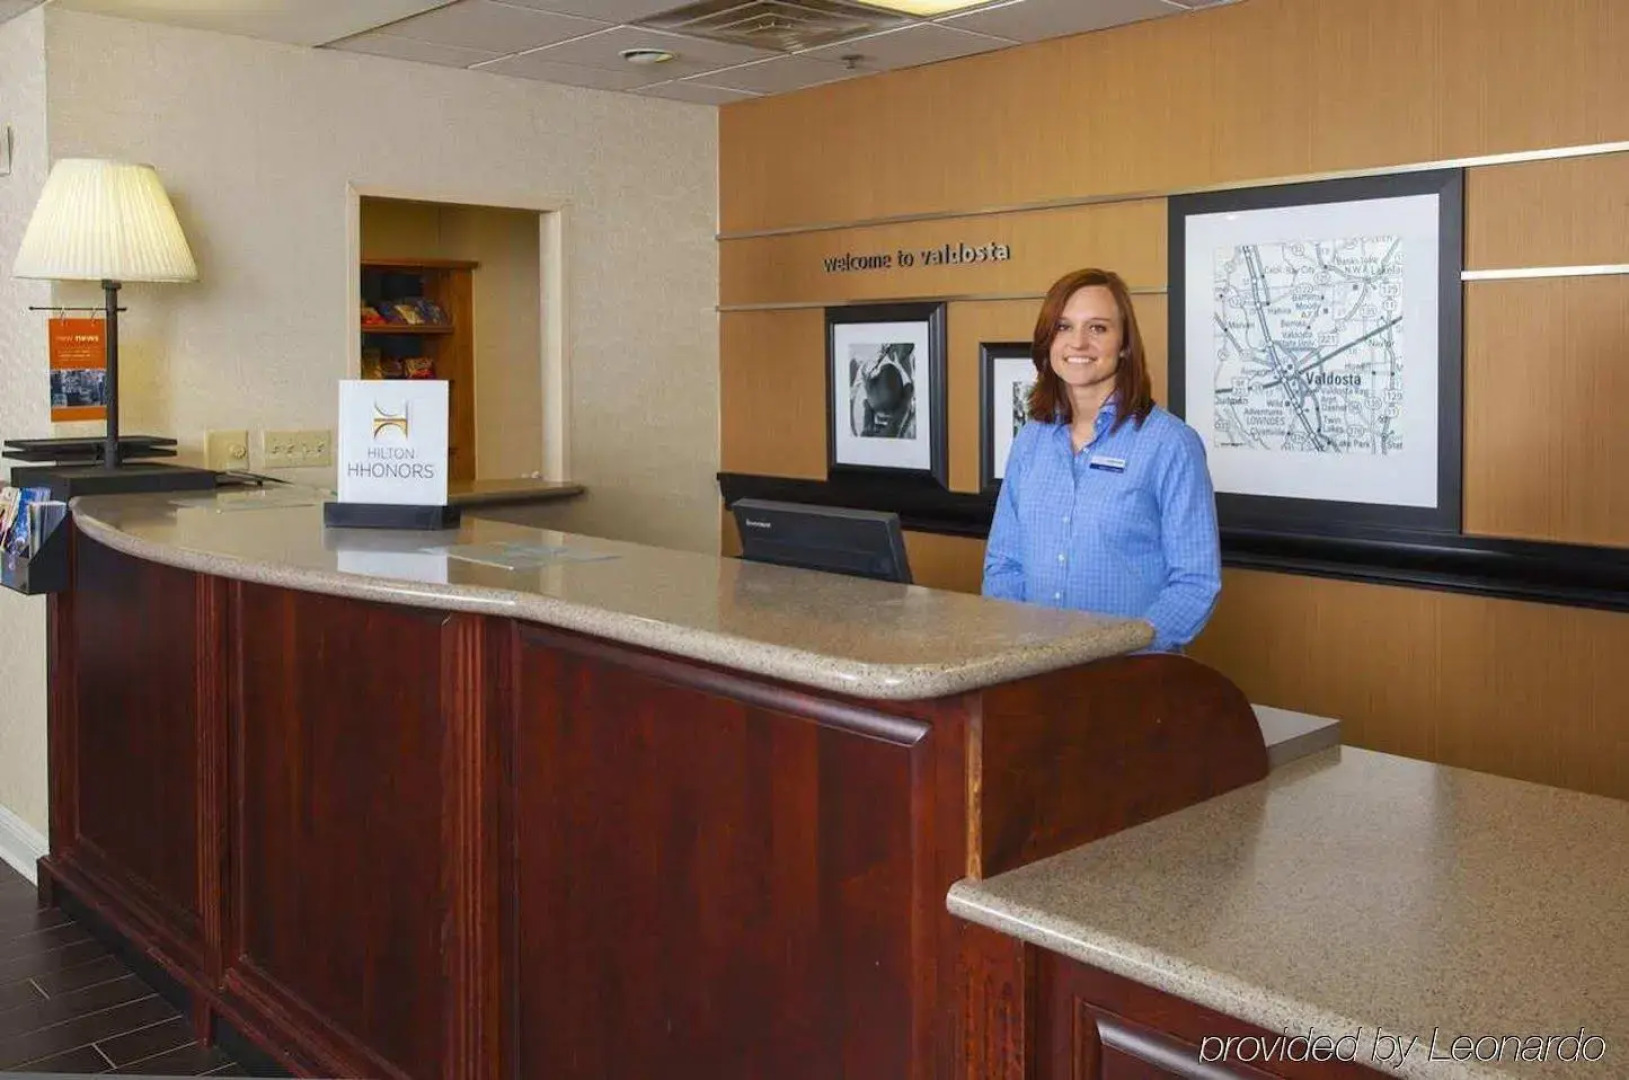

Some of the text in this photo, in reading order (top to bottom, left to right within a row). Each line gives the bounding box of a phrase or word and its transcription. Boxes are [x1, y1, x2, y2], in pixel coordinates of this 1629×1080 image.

[824, 242, 1010, 272] welcome to valdosta
[75, 334, 99, 343] news
[1306, 372, 1362, 386] Valdosta
[367, 447, 415, 460] HILTON
[347, 463, 435, 479] HHONORS
